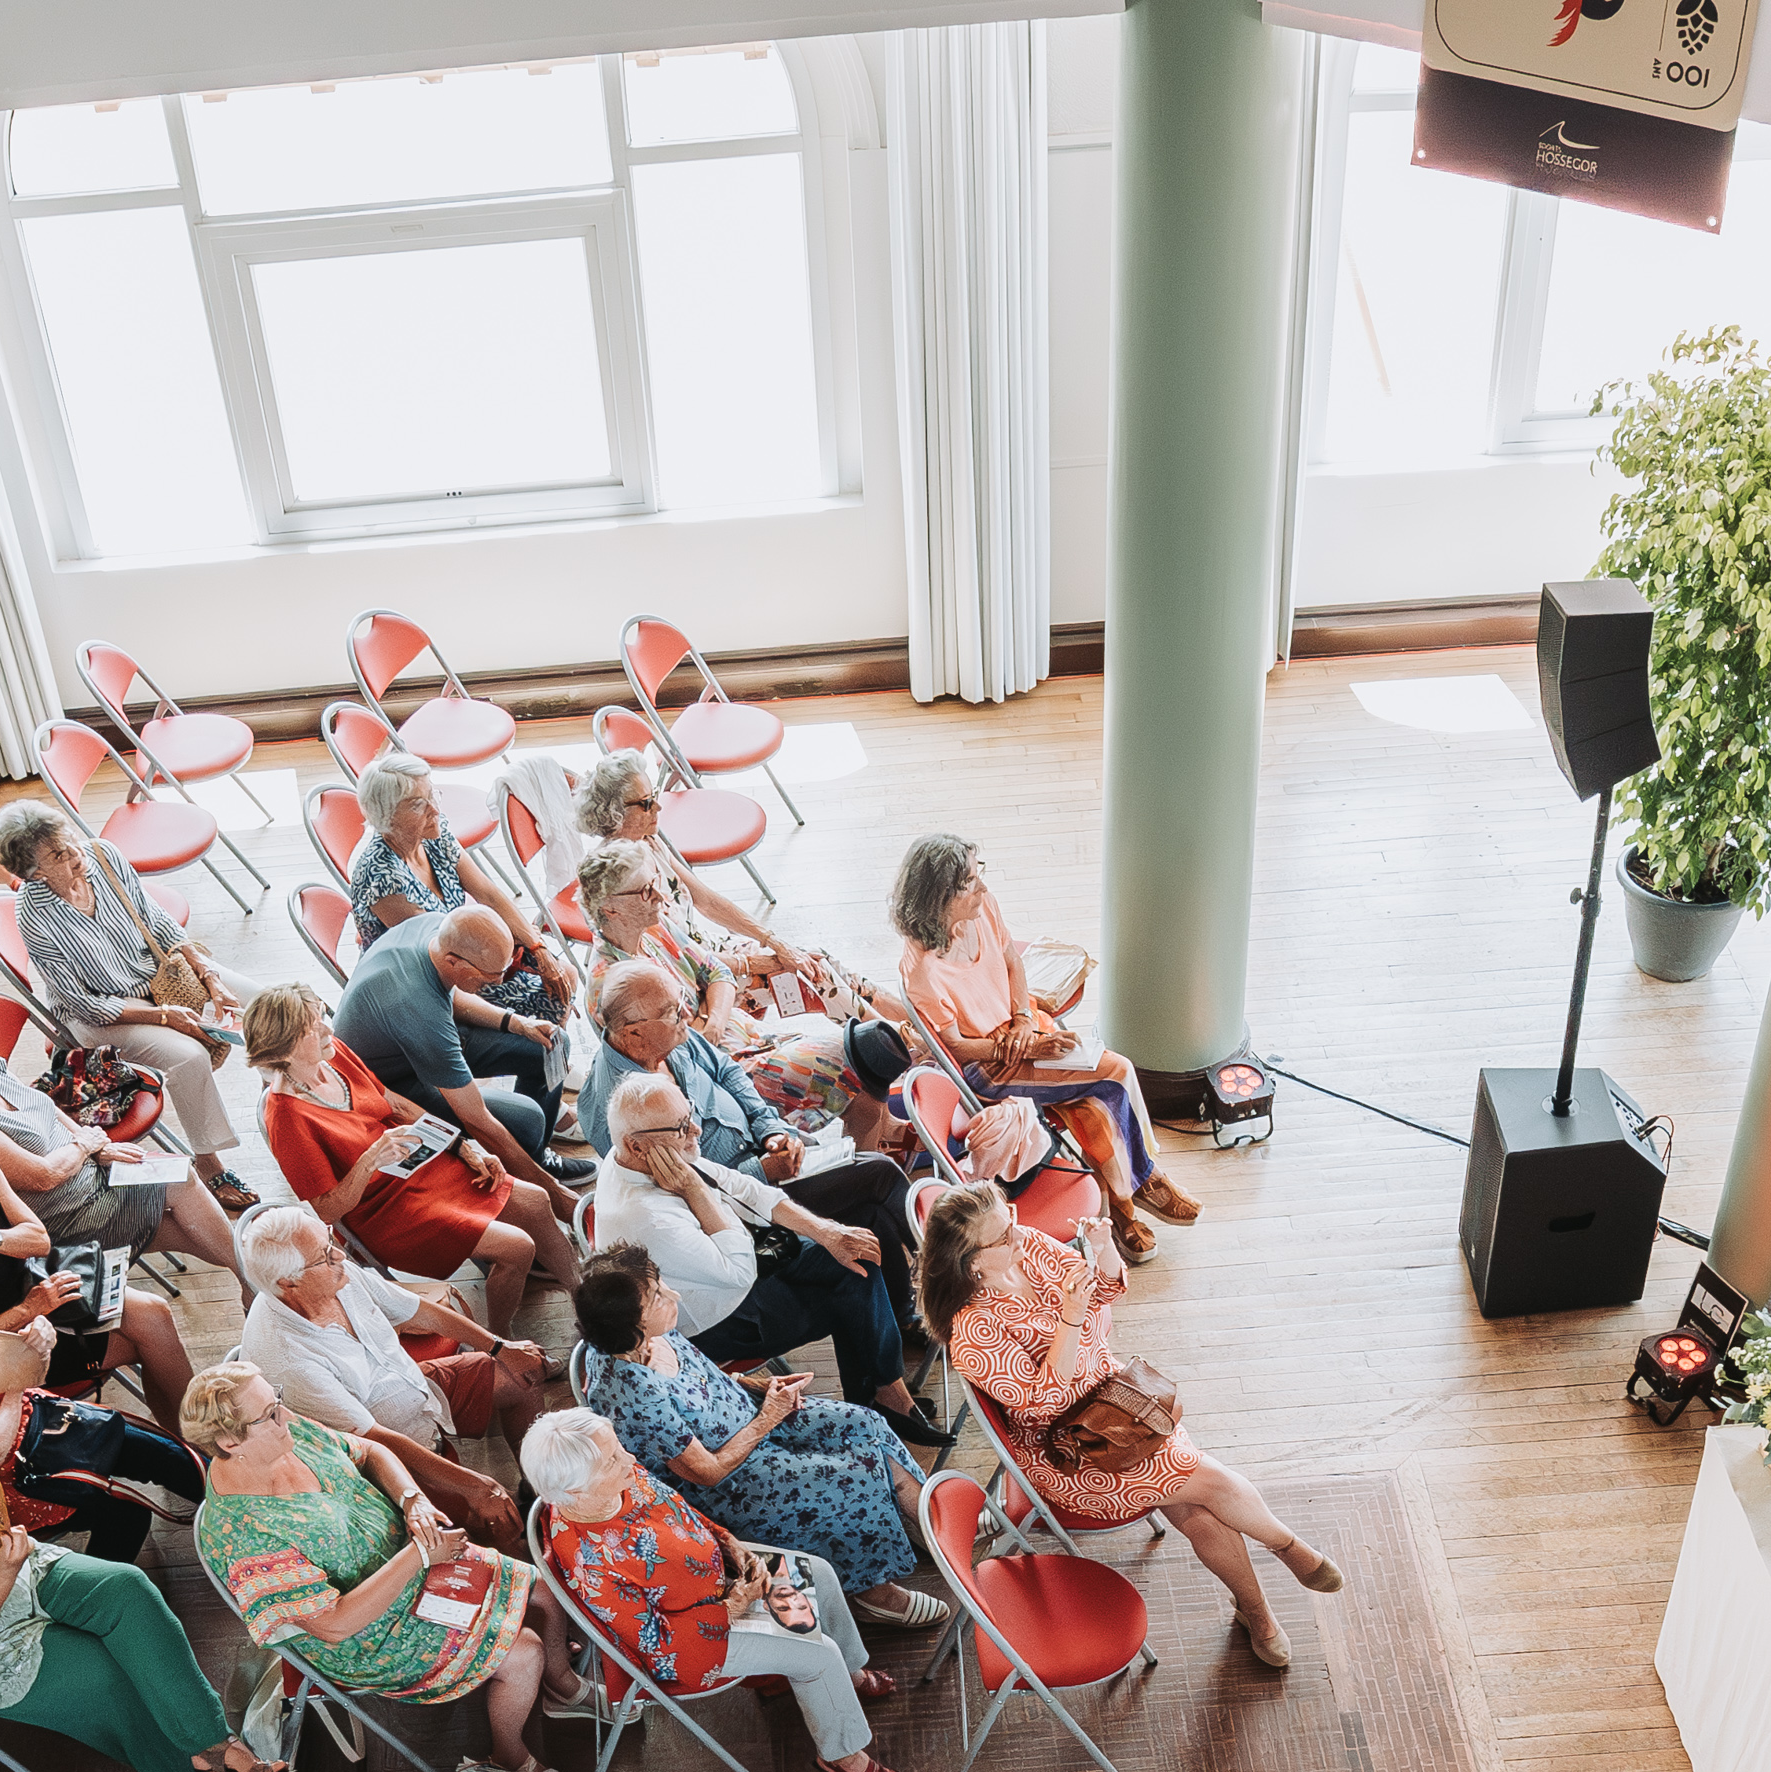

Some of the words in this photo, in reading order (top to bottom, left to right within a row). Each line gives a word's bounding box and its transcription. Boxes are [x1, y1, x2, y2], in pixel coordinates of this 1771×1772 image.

[1652, 58, 1662, 79] ANS
[1666, 61, 1710, 88] 100
[1536, 149, 1598, 174] HOSSEGOR
